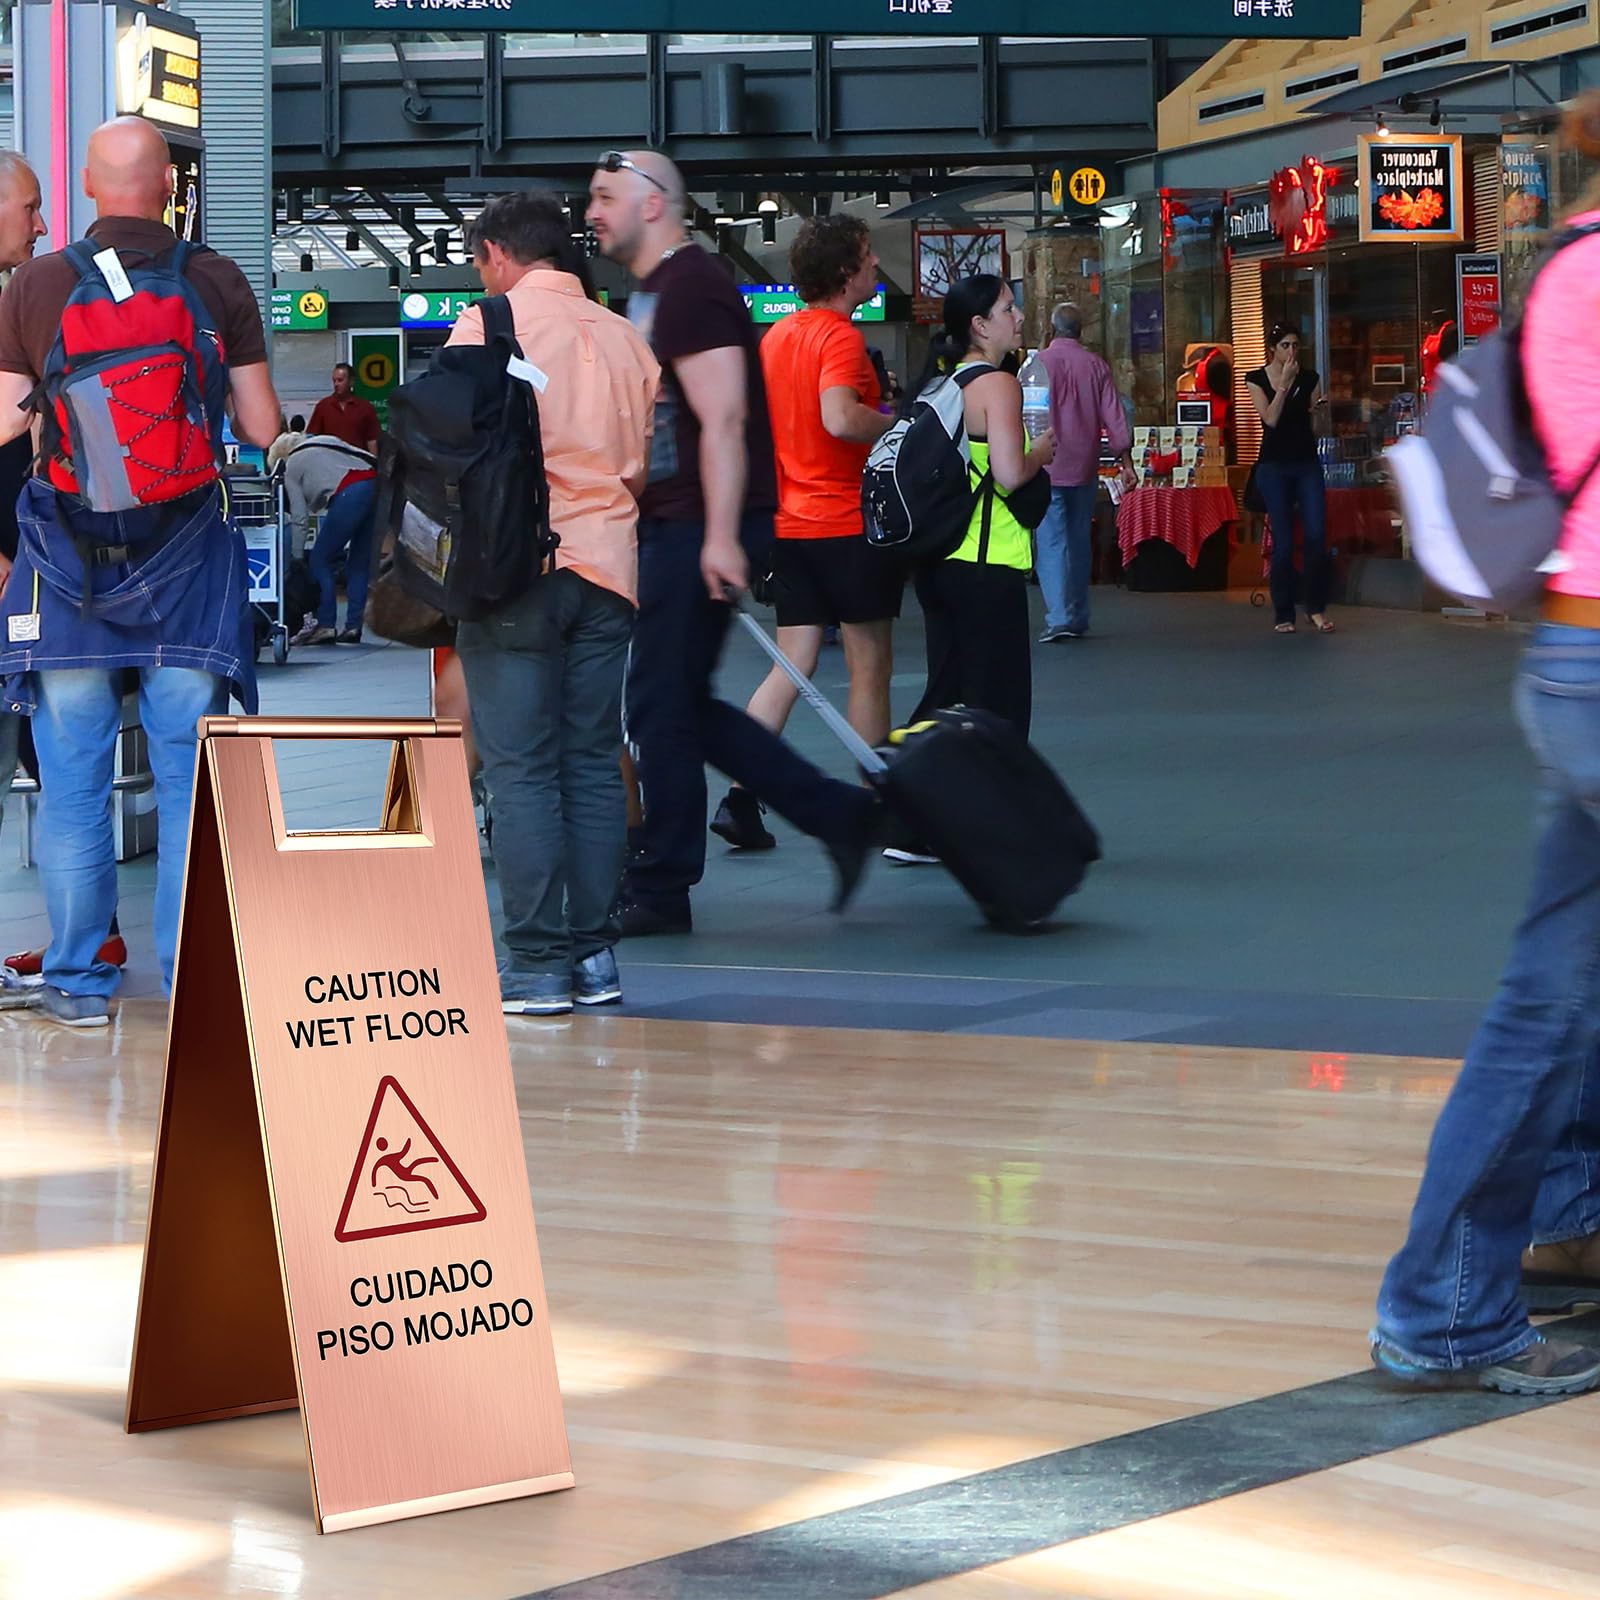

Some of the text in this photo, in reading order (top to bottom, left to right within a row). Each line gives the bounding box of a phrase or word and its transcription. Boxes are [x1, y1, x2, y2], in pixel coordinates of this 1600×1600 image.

[305, 968, 441, 1004] CAUTION
[286, 1009, 470, 1049] WET FLOOR
[351, 1260, 493, 1307] CUIDADO
[318, 1299, 533, 1361] PISO MOJADO
